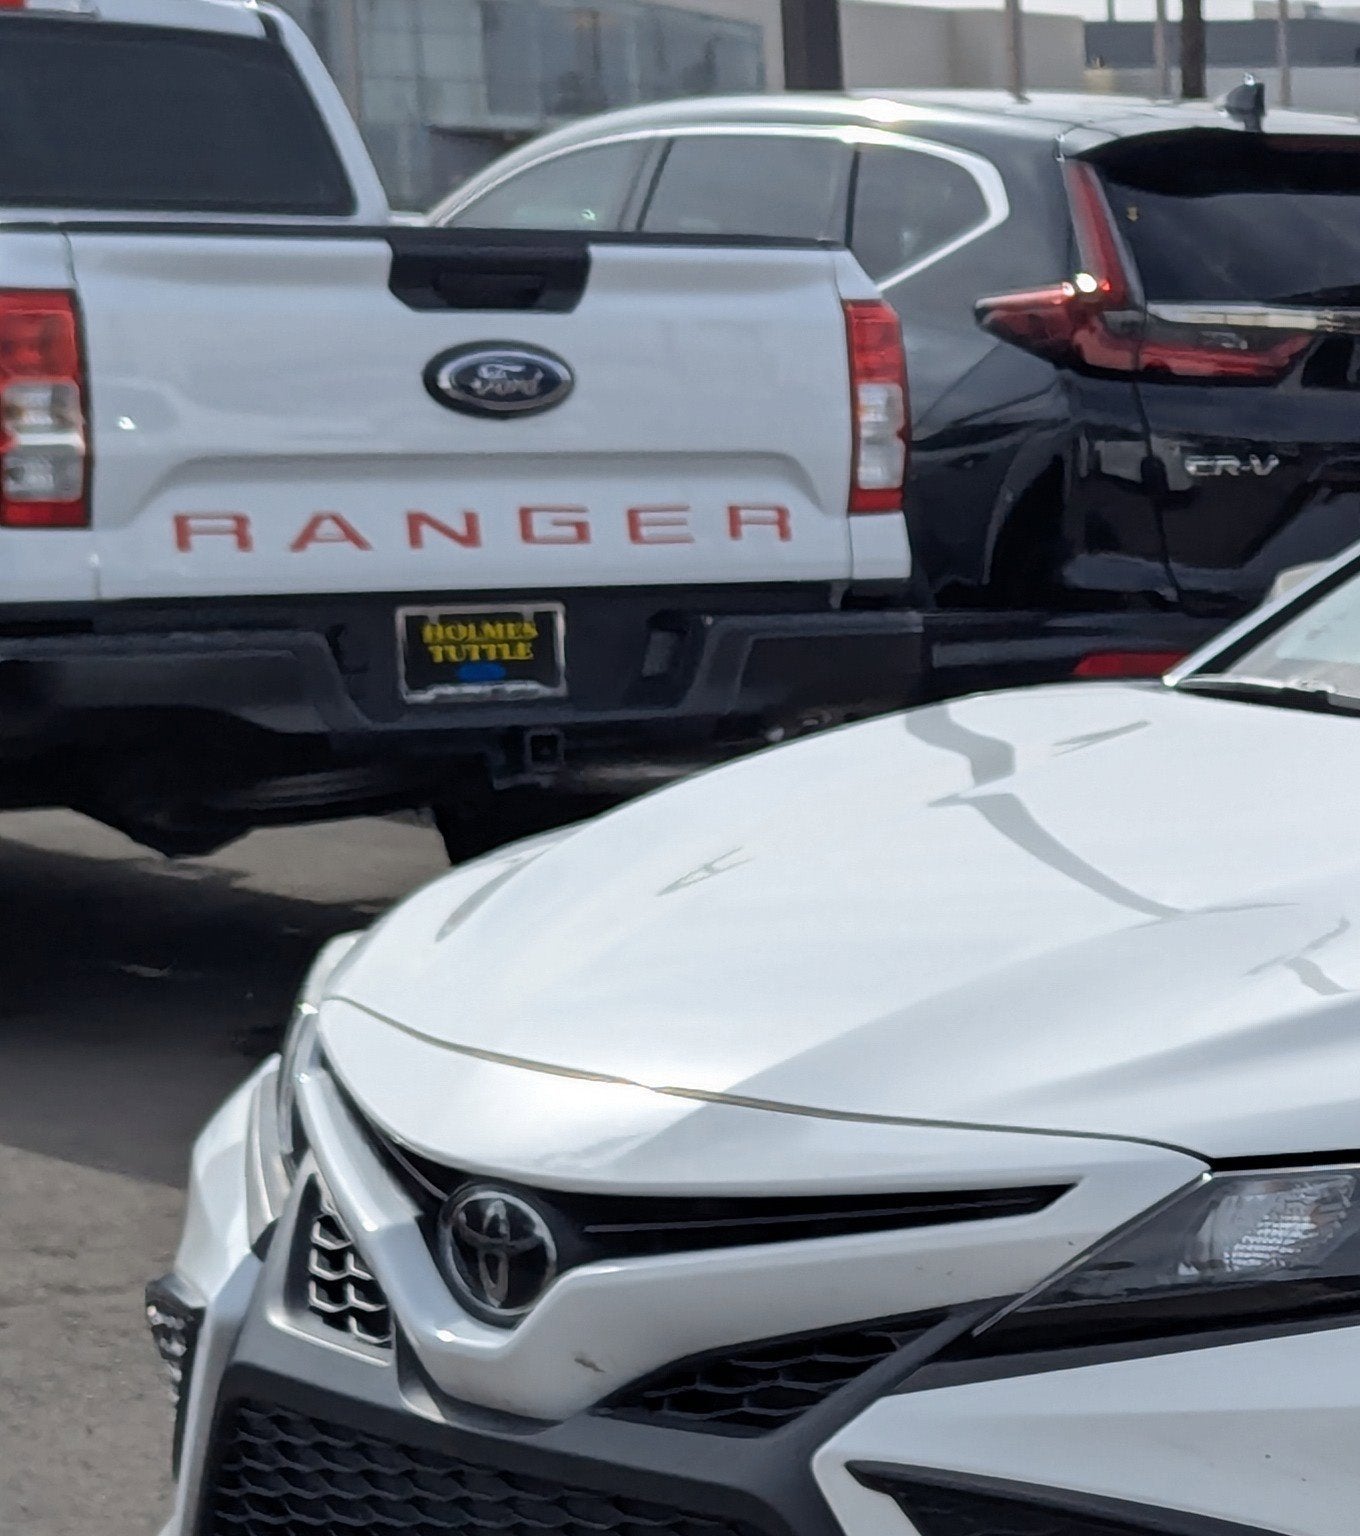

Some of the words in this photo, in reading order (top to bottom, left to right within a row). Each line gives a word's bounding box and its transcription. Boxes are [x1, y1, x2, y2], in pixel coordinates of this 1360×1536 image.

[1184, 453, 1280, 477] CR-V
[173, 503, 793, 553] RANGER
[422, 621, 539, 645] HOLMES
[428, 641, 535, 664] TUTTLE
